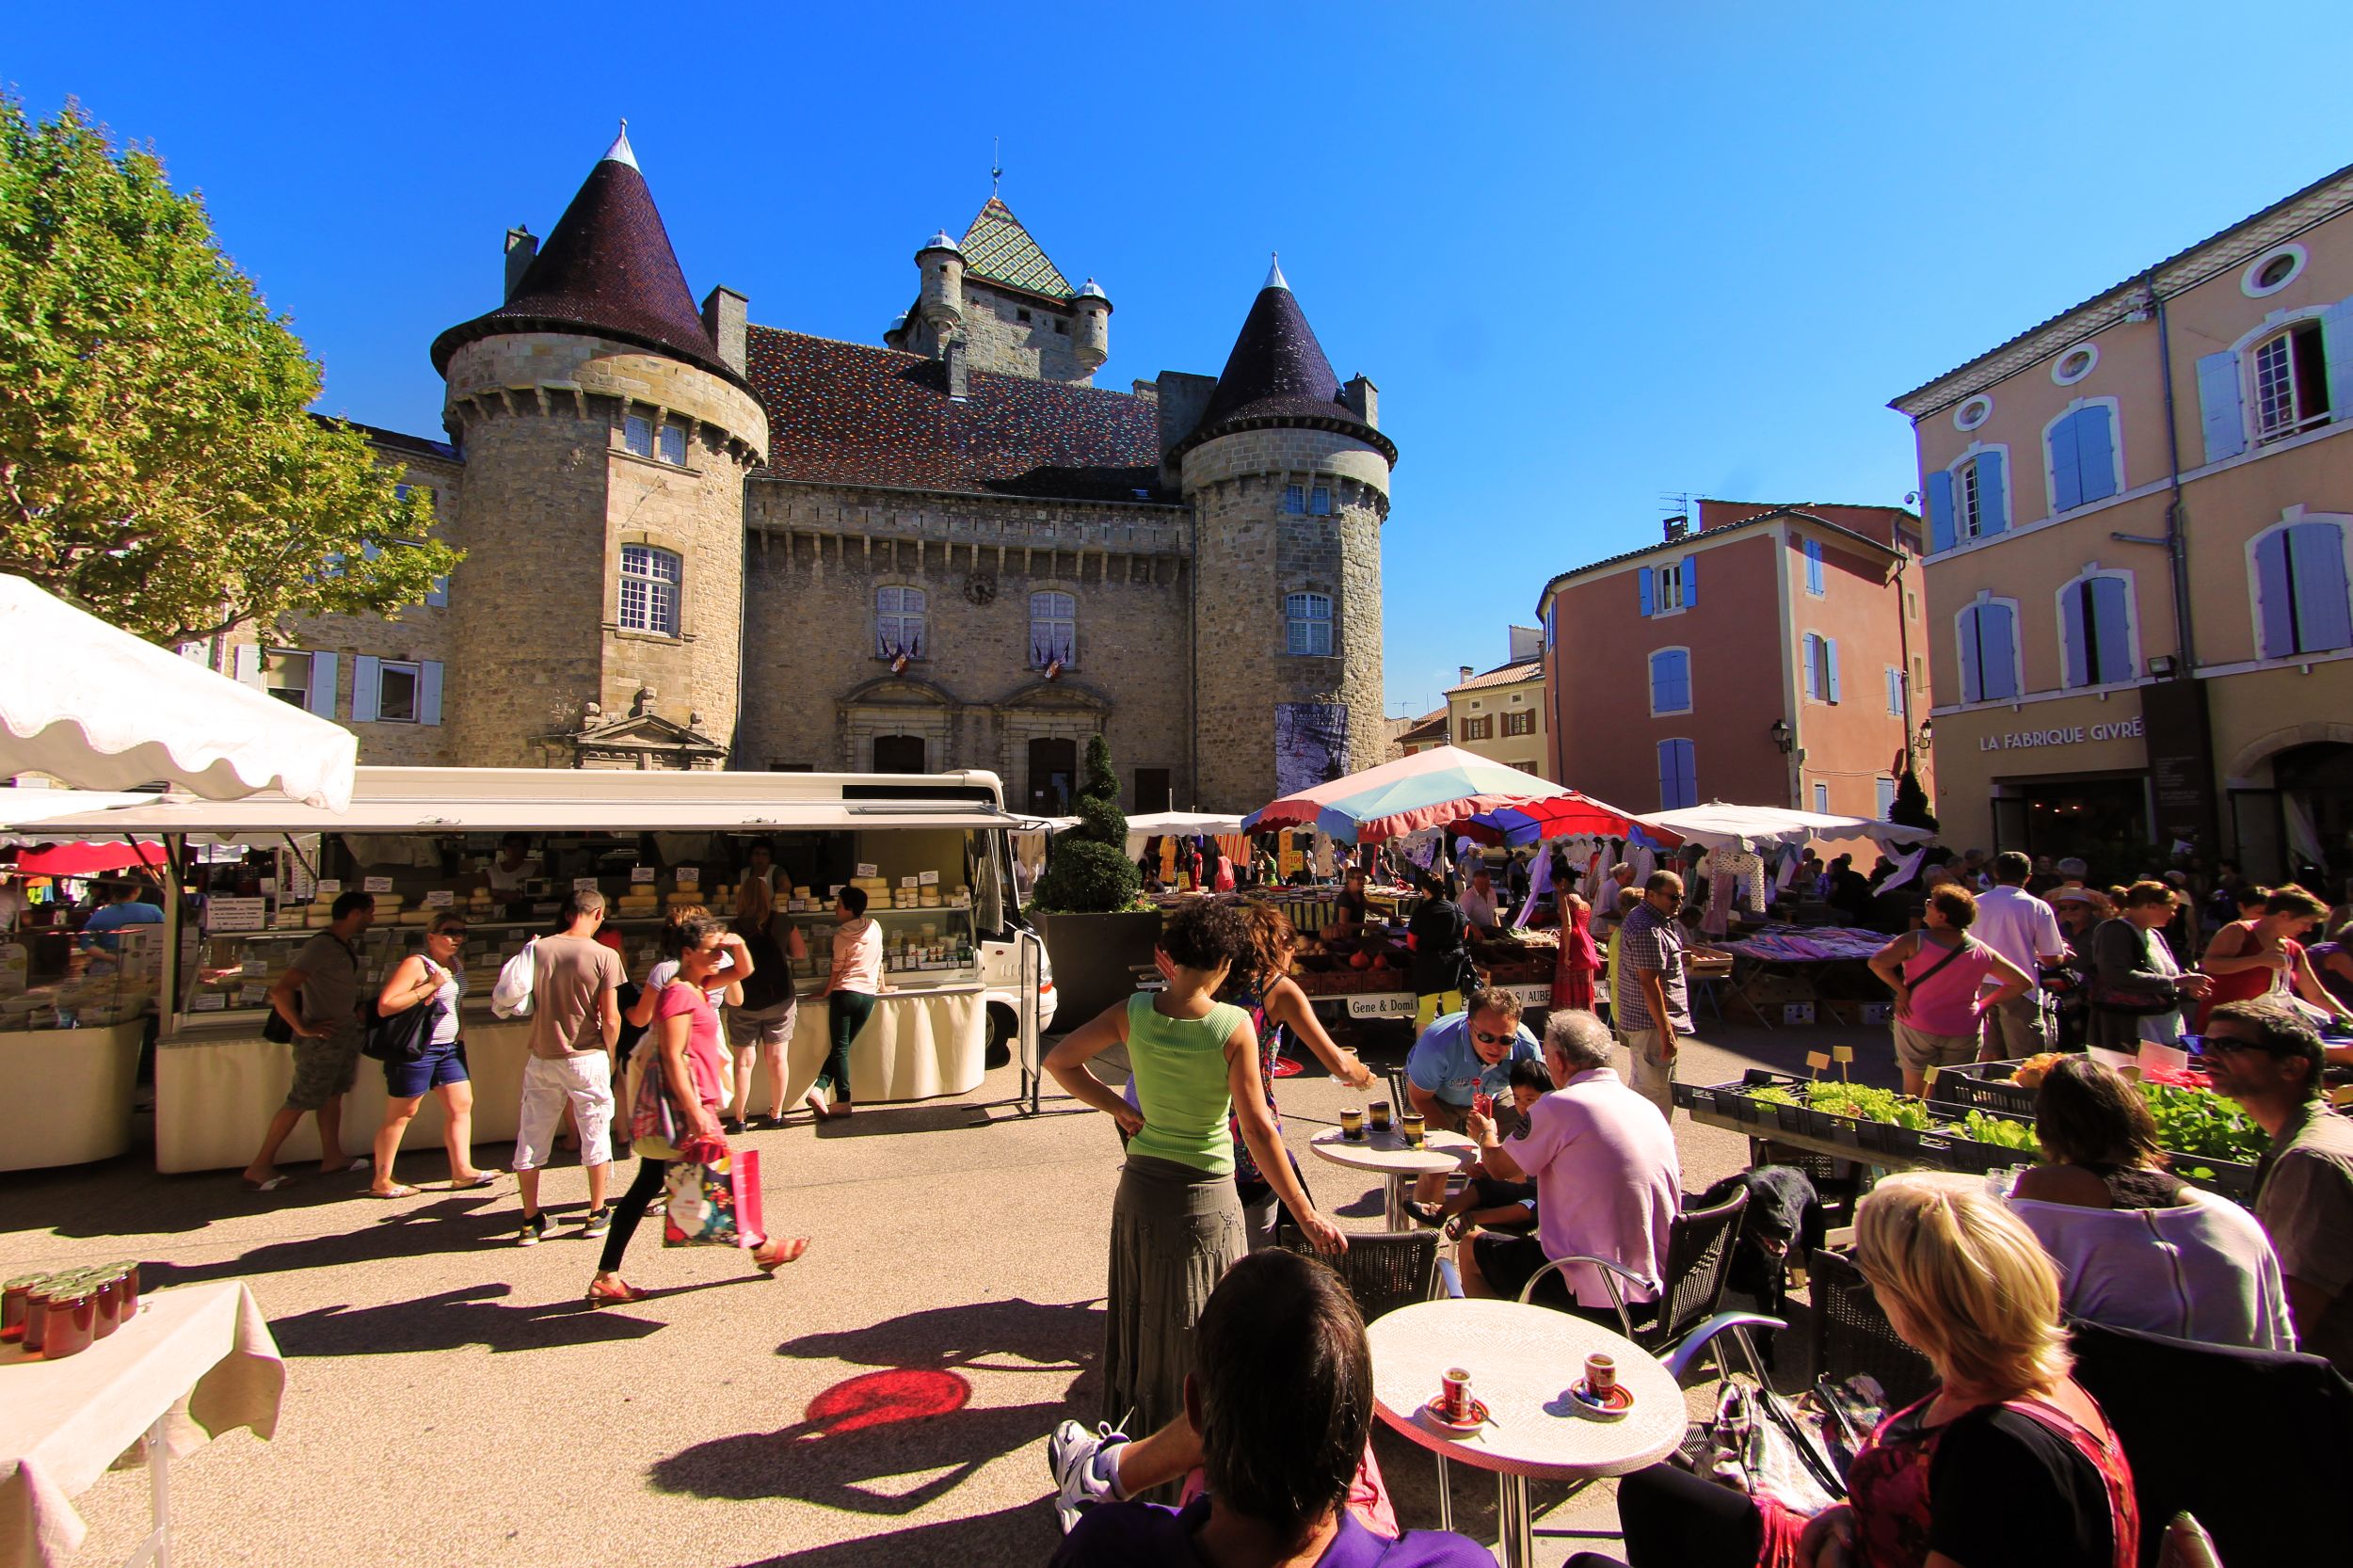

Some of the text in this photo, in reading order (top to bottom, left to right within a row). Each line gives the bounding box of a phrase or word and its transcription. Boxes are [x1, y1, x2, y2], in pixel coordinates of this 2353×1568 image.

[1979, 716, 2143, 751] LA FABRIQUE GIVRÉ
[1289, 856, 1303, 864] 10€
[1528, 989, 1552, 1002] AUBE
[1353, 1000, 1414, 1014] Gene & Domi
